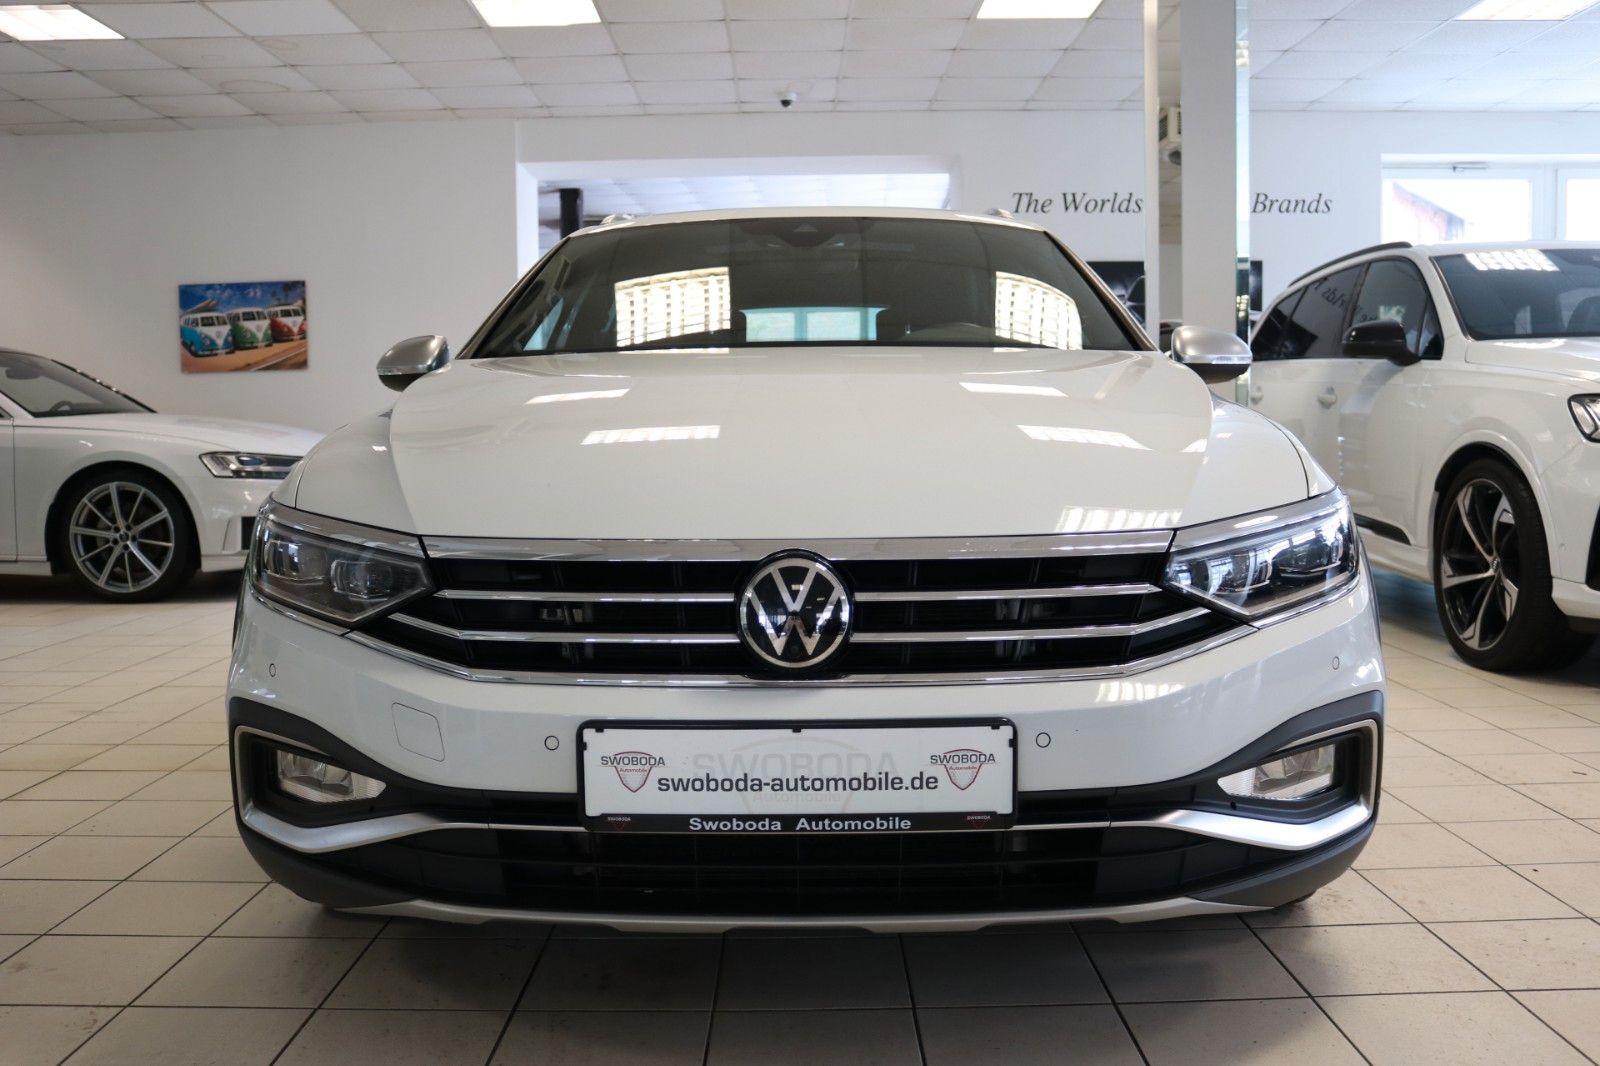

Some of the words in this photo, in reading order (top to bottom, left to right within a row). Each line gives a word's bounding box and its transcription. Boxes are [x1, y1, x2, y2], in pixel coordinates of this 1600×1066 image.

[1011, 192, 1053, 214] The
[1062, 192, 1144, 214] Worlds
[1251, 192, 1332, 214] Brands
[600, 755, 666, 767] SWOBODA
[930, 753, 996, 765] SWOBODA
[657, 771, 939, 793] swoboda-automobile.de
[688, 817, 782, 832] Swoboda
[795, 816, 912, 831] Automobile
